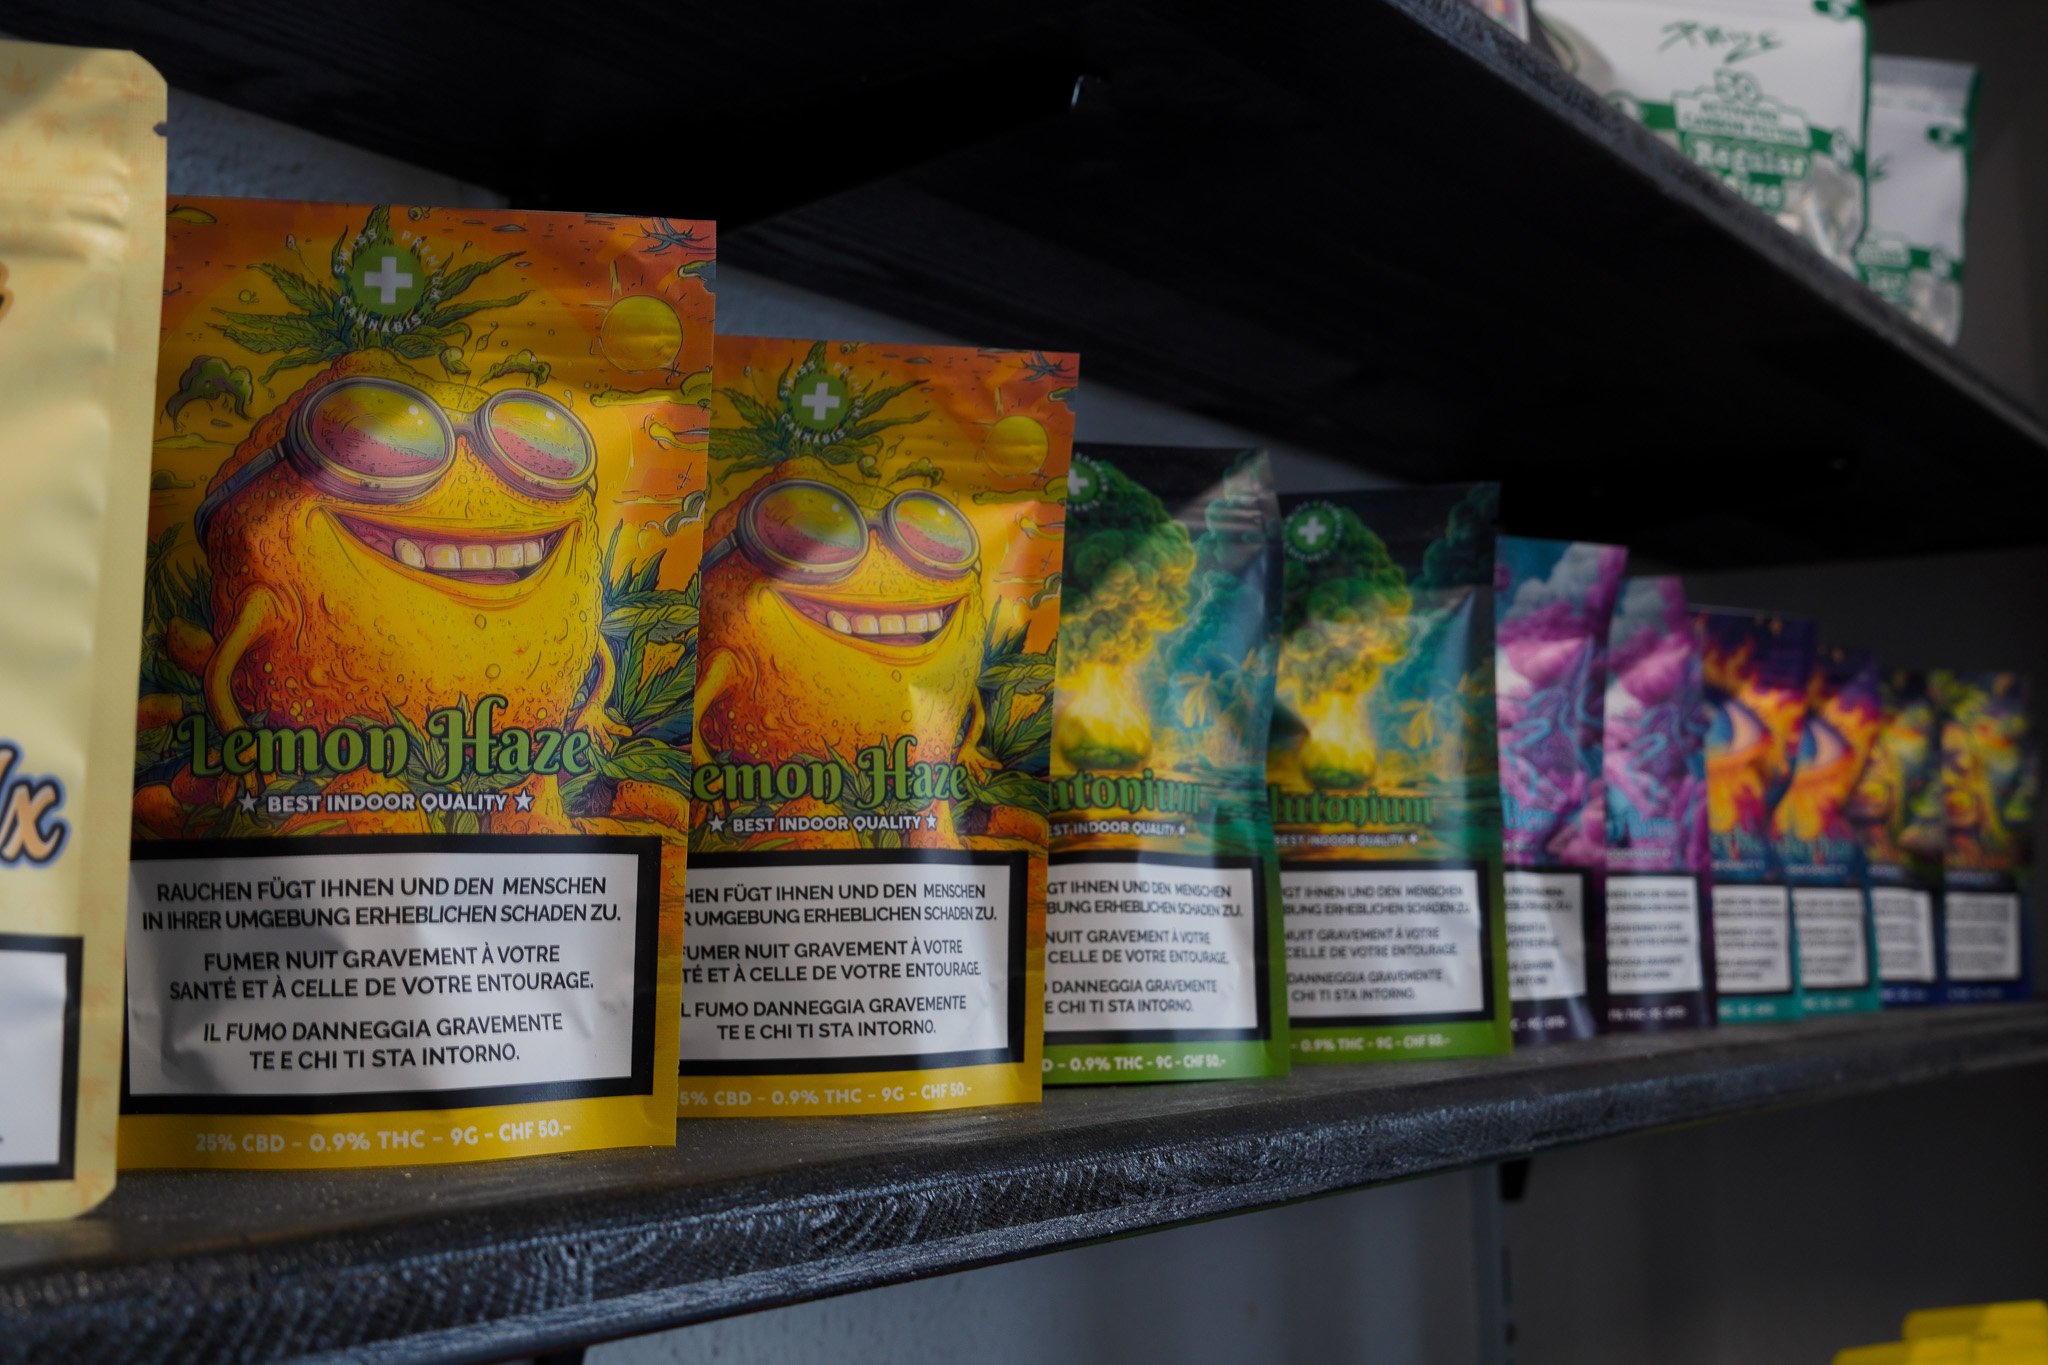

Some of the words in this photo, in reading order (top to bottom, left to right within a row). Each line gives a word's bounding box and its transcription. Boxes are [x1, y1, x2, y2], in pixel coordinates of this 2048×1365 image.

[340, 296, 421, 333] CANNABIS
[177, 710, 412, 779] Lemon
[428, 695, 592, 785] Haze
[692, 761, 844, 802] emon
[857, 735, 968, 809] Haze
[1050, 768, 1200, 813] utonium
[267, 794, 323, 814] BEST
[327, 793, 416, 813] INDOOR
[421, 793, 507, 814] QUALITY
[732, 818, 775, 832] BEST
[779, 816, 848, 832] INDOOR
[853, 816, 921, 832] QUALITY
[1074, 821, 1129, 833] INDOOR
[1132, 822, 1175, 835] QUALITY
[1309, 834, 1355, 846] INDOOR
[1358, 833, 1405, 847] QUALITY
[156, 881, 252, 902] RAUCHEN
[258, 877, 316, 899] FÜGT
[321, 878, 394, 897] IHNEN
[401, 877, 449, 896] UND
[455, 877, 493, 895] DEN
[503, 877, 607, 895] MENSCHEN
[686, 888, 718, 903] HEN
[724, 883, 772, 902] FÜGT
[776, 886, 833, 900] IHNEN
[839, 885, 878, 899] UND
[884, 884, 916, 898] DEN
[924, 884, 985, 898] MENSCHEN
[1071, 882, 1119, 893] IHNEN
[1122, 882, 1150, 894] UND
[1152, 882, 1171, 895] DEN
[1175, 884, 1231, 897] MENSCHEN
[1305, 886, 1344, 897] IHNEN
[1350, 886, 1373, 897] UND
[1377, 886, 1400, 897] DEN
[143, 913, 163, 930] IN
[168, 911, 221, 930] IHRER
[226, 908, 350, 929] UMGEBUNG
[356, 906, 497, 925] ERHEBLICHEN
[501, 905, 586, 923] SCHADEN
[590, 904, 621, 922] ZU.
[695, 910, 800, 925] UMGEBUNG
[804, 907, 921, 922] ERHEBLICHEN
[925, 907, 973, 921] SCHADEN
[975, 906, 997, 920] ZU.
[1046, 902, 1091, 915] BUNG
[1095, 901, 1176, 914] ERHEBLICHEN
[1178, 902, 1220, 916] SCHADEN
[1223, 904, 1243, 916] ZU.
[1046, 931, 1082, 944] NUIT
[1087, 930, 1169, 943] GRAVEMENT
[1181, 931, 1210, 944] VOTRE
[1317, 928, 1392, 940] GRAVEMENT
[1406, 927, 1439, 938] VOTRE
[205, 952, 281, 972] FUMER
[287, 951, 338, 969] NUIT
[343, 947, 478, 968] GRAVEMENT
[482, 942, 493, 964] À
[498, 945, 560, 964] VOTRE
[683, 945, 739, 960] UMER
[745, 944, 790, 958] NUIT
[794, 941, 908, 957] GRAVEMENT
[911, 937, 921, 955] À
[924, 939, 962, 954] VOTRE
[1048, 950, 1097, 963] CELLE
[1102, 950, 1121, 962] DE
[1125, 950, 1166, 962] VOTRE
[1287, 947, 1325, 959] CELLE
[1330, 947, 1346, 958] DE
[1350, 946, 1388, 958] VOTRE
[708, 968, 730, 982] ET
[733, 964, 746, 982] À
[750, 966, 807, 981] CELLE
[813, 965, 836, 980] DE
[841, 964, 901, 979] VOTRE
[1288, 972, 1364, 983] DANNEGGIA
[1368, 969, 1442, 983] GRAVEMENTE
[170, 975, 237, 1000] SANTÉ
[243, 980, 269, 998] ET
[273, 975, 286, 997] À
[291, 979, 359, 998] CELLE
[367, 978, 395, 996] DE
[402, 975, 472, 994] VOTRE
[477, 972, 594, 993] ENTOURAGE.
[1052, 980, 1142, 993] DANNEGGIA
[1146, 979, 1217, 993] GRAVEMENTE
[1292, 989, 1316, 1000] CHI
[1320, 989, 1330, 1000] TI
[1336, 988, 1357, 1000] STA
[695, 1001, 748, 1017] FUMO
[753, 999, 864, 1016] DANNEGGIA
[869, 996, 966, 1012] GRAVEMENTE
[1059, 1000, 1085, 1013] CHI
[1090, 1000, 1104, 1012] TI
[1108, 1000, 1135, 1012] STA
[204, 1024, 221, 1042] IL
[226, 1022, 287, 1042] FUMO
[293, 1020, 431, 1040] DANNEGGIA
[437, 1013, 563, 1037] GRAVEMENTE
[717, 1025, 739, 1040] TE
[745, 1025, 755, 1039] E
[760, 1025, 792, 1039] CHI
[799, 1024, 814, 1038] TI
[818, 1022, 853, 1037] STA
[858, 1020, 936, 1036] INTORNO.
[250, 1051, 275, 1070] TE
[281, 1051, 293, 1070] E
[299, 1051, 337, 1070] CHI
[343, 1050, 364, 1068] TI
[372, 1047, 416, 1067] STA
[422, 1043, 520, 1066] INTORNO.
[1070, 1056, 1110, 1071] 0.9%
[1115, 1056, 1143, 1070] THC
[680, 1090, 708, 1106] 5%
[714, 1091, 751, 1106] CBD
[772, 1089, 818, 1105] 0.9%
[824, 1089, 862, 1104] THC
[882, 1087, 904, 1101] 9G
[921, 1084, 947, 1098] CHF
[196, 1132, 236, 1152] 25%
[242, 1134, 285, 1152] CBD
[310, 1131, 371, 1152] 0.9%
[378, 1129, 425, 1149] THC
[450, 1127, 478, 1145] 9G
[499, 1123, 534, 1139] CHF
